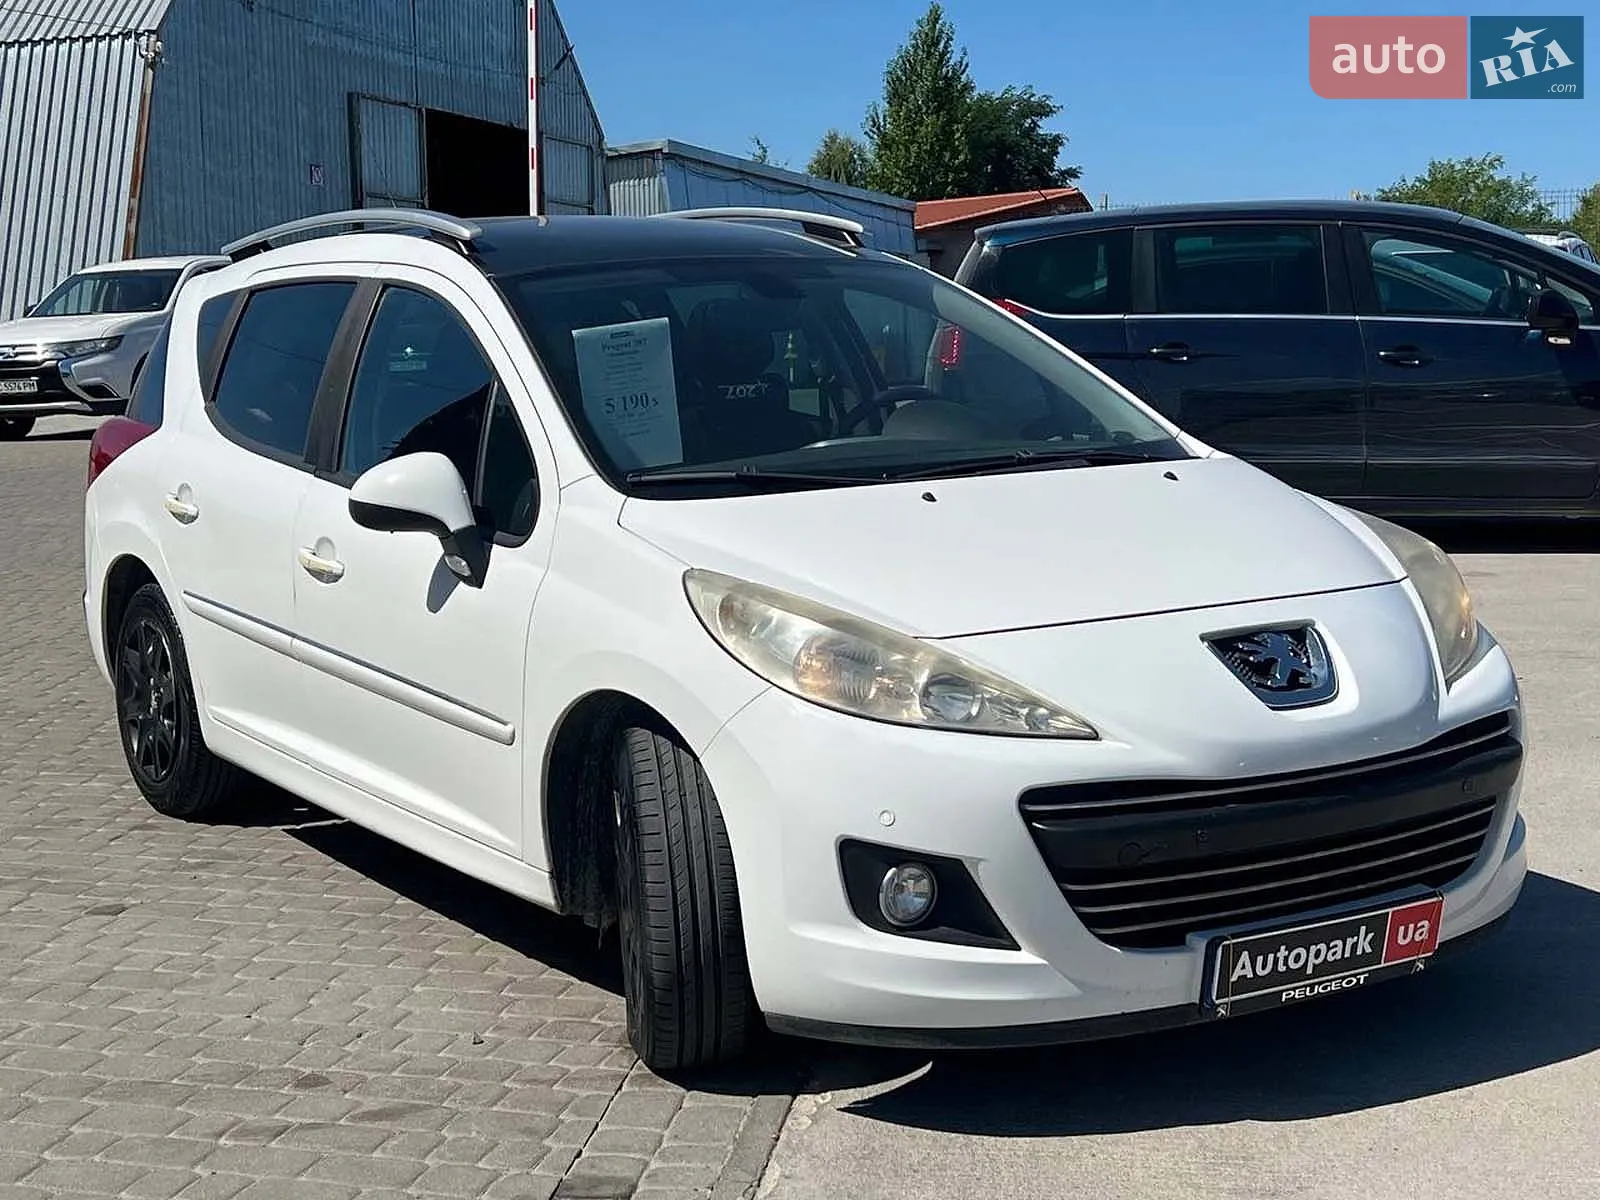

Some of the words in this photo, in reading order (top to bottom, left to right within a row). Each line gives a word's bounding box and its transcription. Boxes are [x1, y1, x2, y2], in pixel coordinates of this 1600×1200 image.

[1230, 926, 1375, 983] Autopark
[1397, 919, 1430, 945] ua
[1281, 973, 1369, 1002] PEUGEOT
